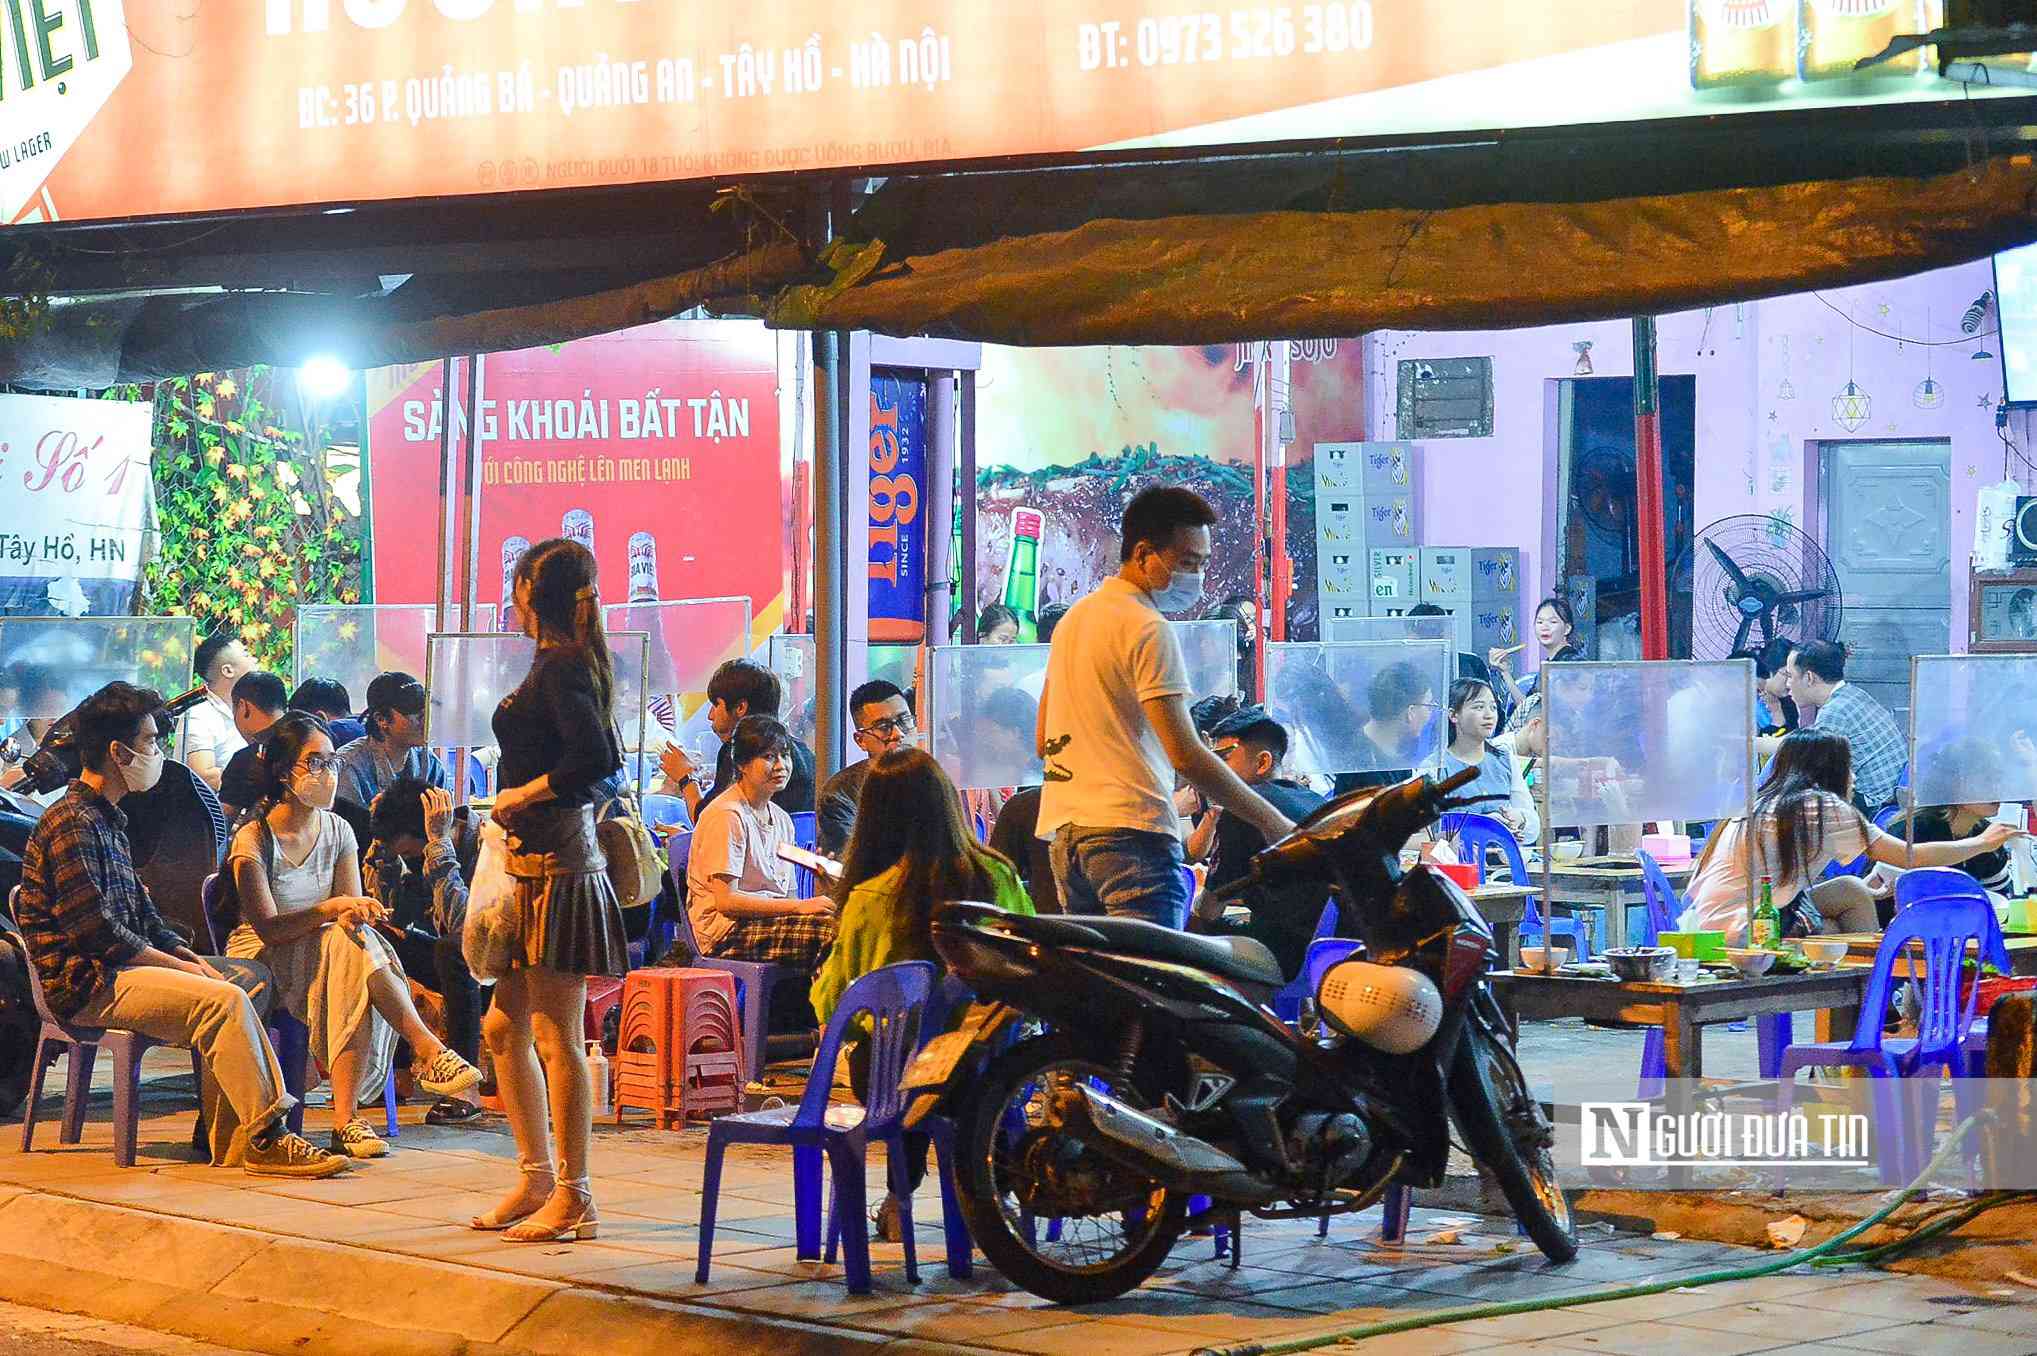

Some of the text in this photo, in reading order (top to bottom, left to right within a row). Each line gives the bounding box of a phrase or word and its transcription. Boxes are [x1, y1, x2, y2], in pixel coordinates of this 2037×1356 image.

[1136, 13, 1223, 66] 0973
[1230, 7, 1297, 58] 526
[1303, 1, 1374, 54] 380
[344, 81, 376, 125] 36
[380, 79, 400, 122] P.
[404, 63, 492, 127] QUẢNG
[497, 58, 534, 113] BÁ
[557, 51, 649, 117] QUẢNG
[655, 58, 694, 104] AN
[719, 42, 776, 98] TÂY
[783, 31, 823, 94] HỒ
[849, 30, 891, 89] HÀ
[898, 24, 952, 92] NỘI
[14, 131, 53, 163] LAGER
[507, 387, 609, 441] KHOÁI
[619, 386, 682, 440] BẤT
[688, 389, 750, 445] TẬN
[24, 429, 104, 493] Số
[483, 453, 692, 488] ỚI CÔNG NGHỆ LÊN MEN LẠNH
[900, 426, 910, 577] SINCE 1932
[43, 532, 81, 565] Hồ,
[90, 537, 126, 562] HN
[1478, 559, 1498, 577] Tiger
[1375, 584, 1393, 597] en
[1478, 613, 1499, 629] Tiger
